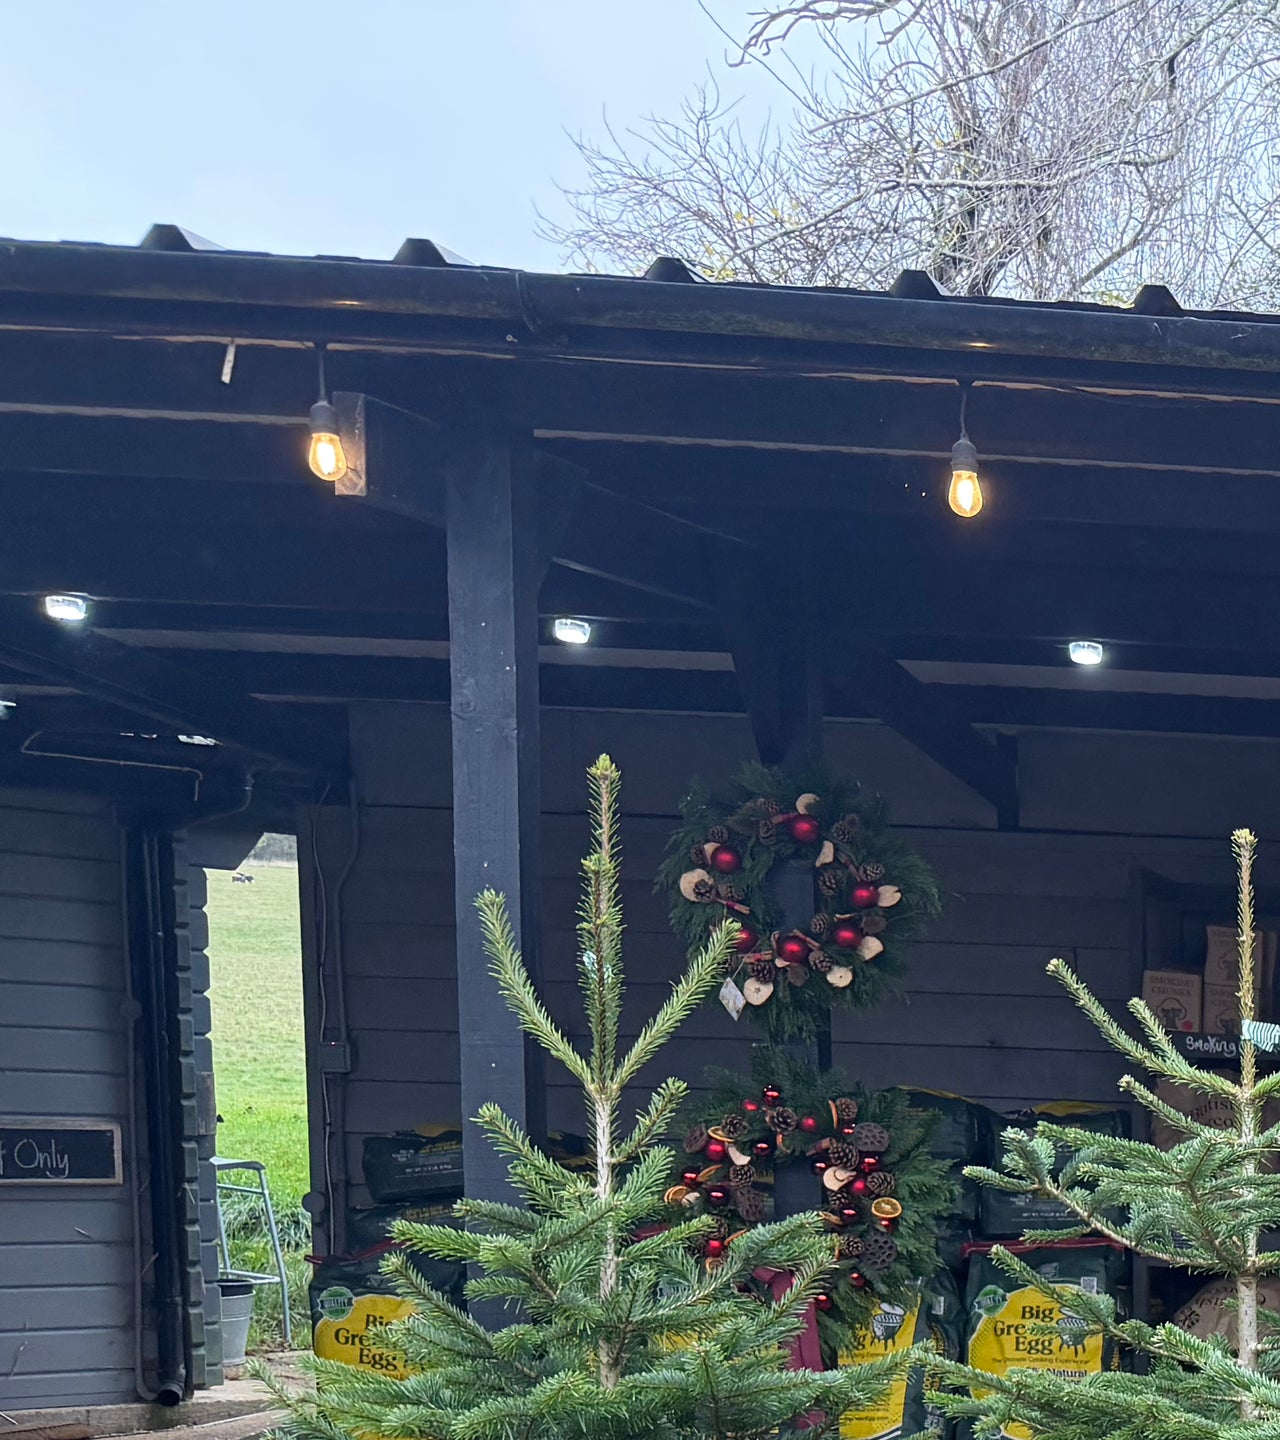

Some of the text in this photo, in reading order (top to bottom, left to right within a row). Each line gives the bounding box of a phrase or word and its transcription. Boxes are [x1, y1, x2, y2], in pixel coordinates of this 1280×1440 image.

[14, 1138, 69, 1179] Only
[1021, 1305, 1055, 1324] Big
[334, 1327, 370, 1347] Gre
[1014, 1335, 1054, 1356] Egg
[359, 1347, 398, 1372] Egg
